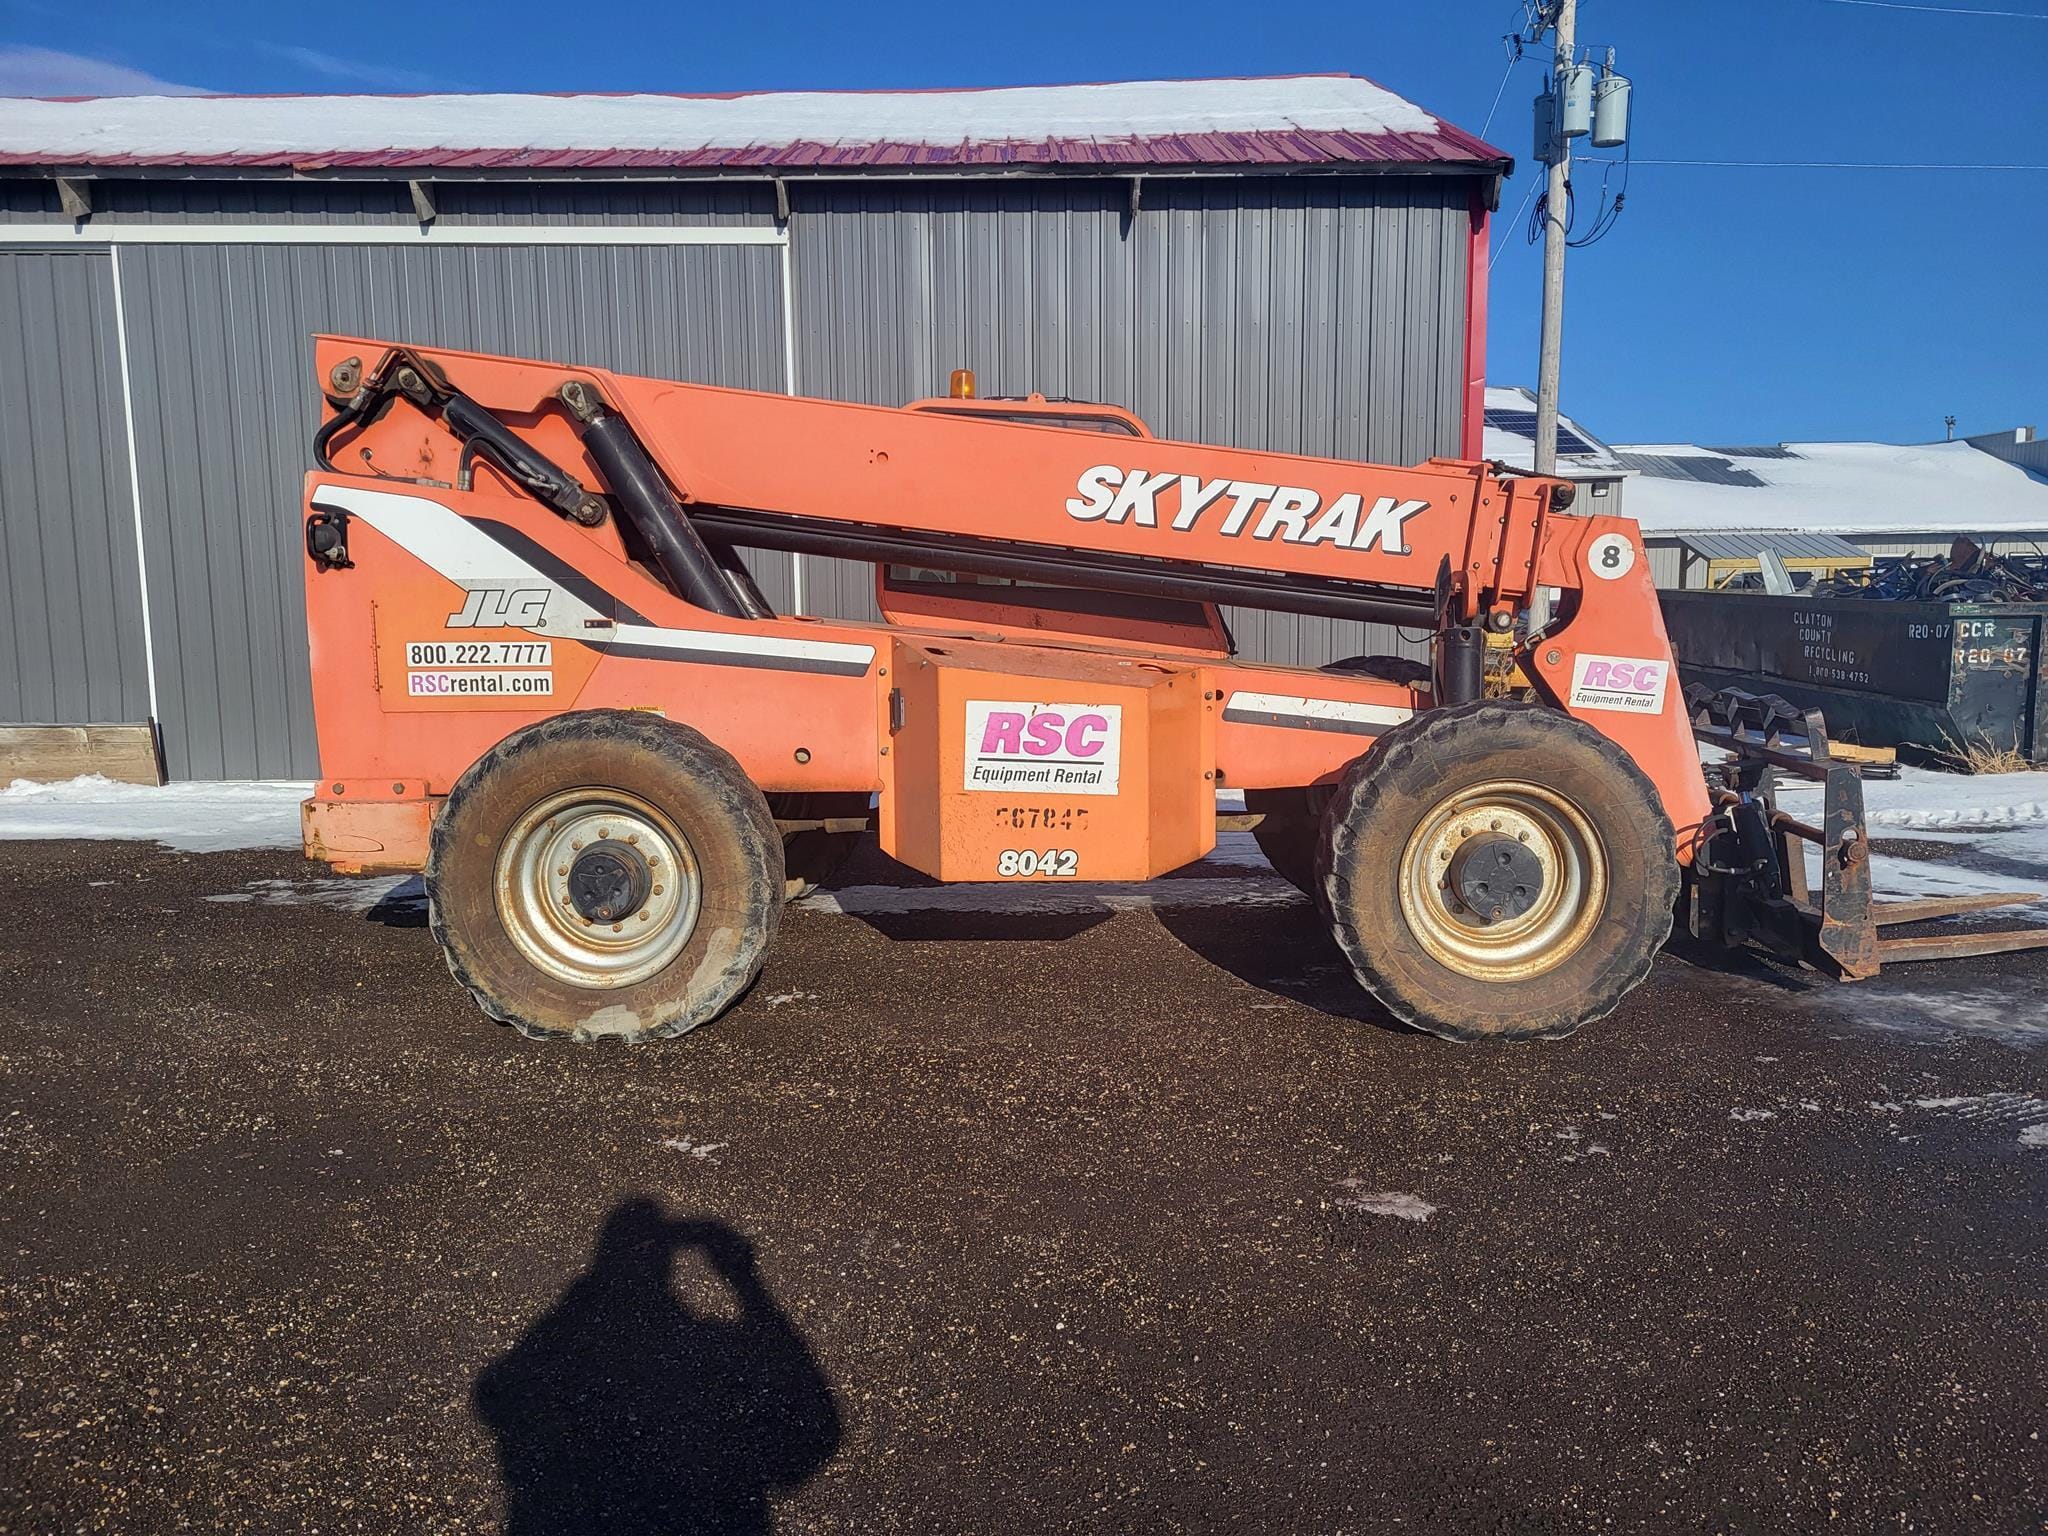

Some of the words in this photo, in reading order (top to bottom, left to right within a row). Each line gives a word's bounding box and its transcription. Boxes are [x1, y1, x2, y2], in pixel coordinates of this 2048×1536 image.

[1065, 464, 1431, 556] SKYTRAK
[1601, 545, 1620, 568] 8
[445, 589, 551, 628] JLG
[1793, 611, 1832, 628] CLAYTON
[1799, 628, 1832, 644] COUNTY
[1960, 622, 1996, 638] CCR
[411, 645, 547, 664] 800.222.7777
[411, 675, 550, 693] RSCrental.com
[1582, 661, 1659, 692] RSC
[1576, 692, 1622, 706] Equipment
[1624, 696, 1654, 708] Rental
[980, 711, 1109, 758] RSC
[972, 765, 1051, 785] Equipment
[1053, 768, 1103, 785] Rental
[997, 848, 1079, 878] 8042
